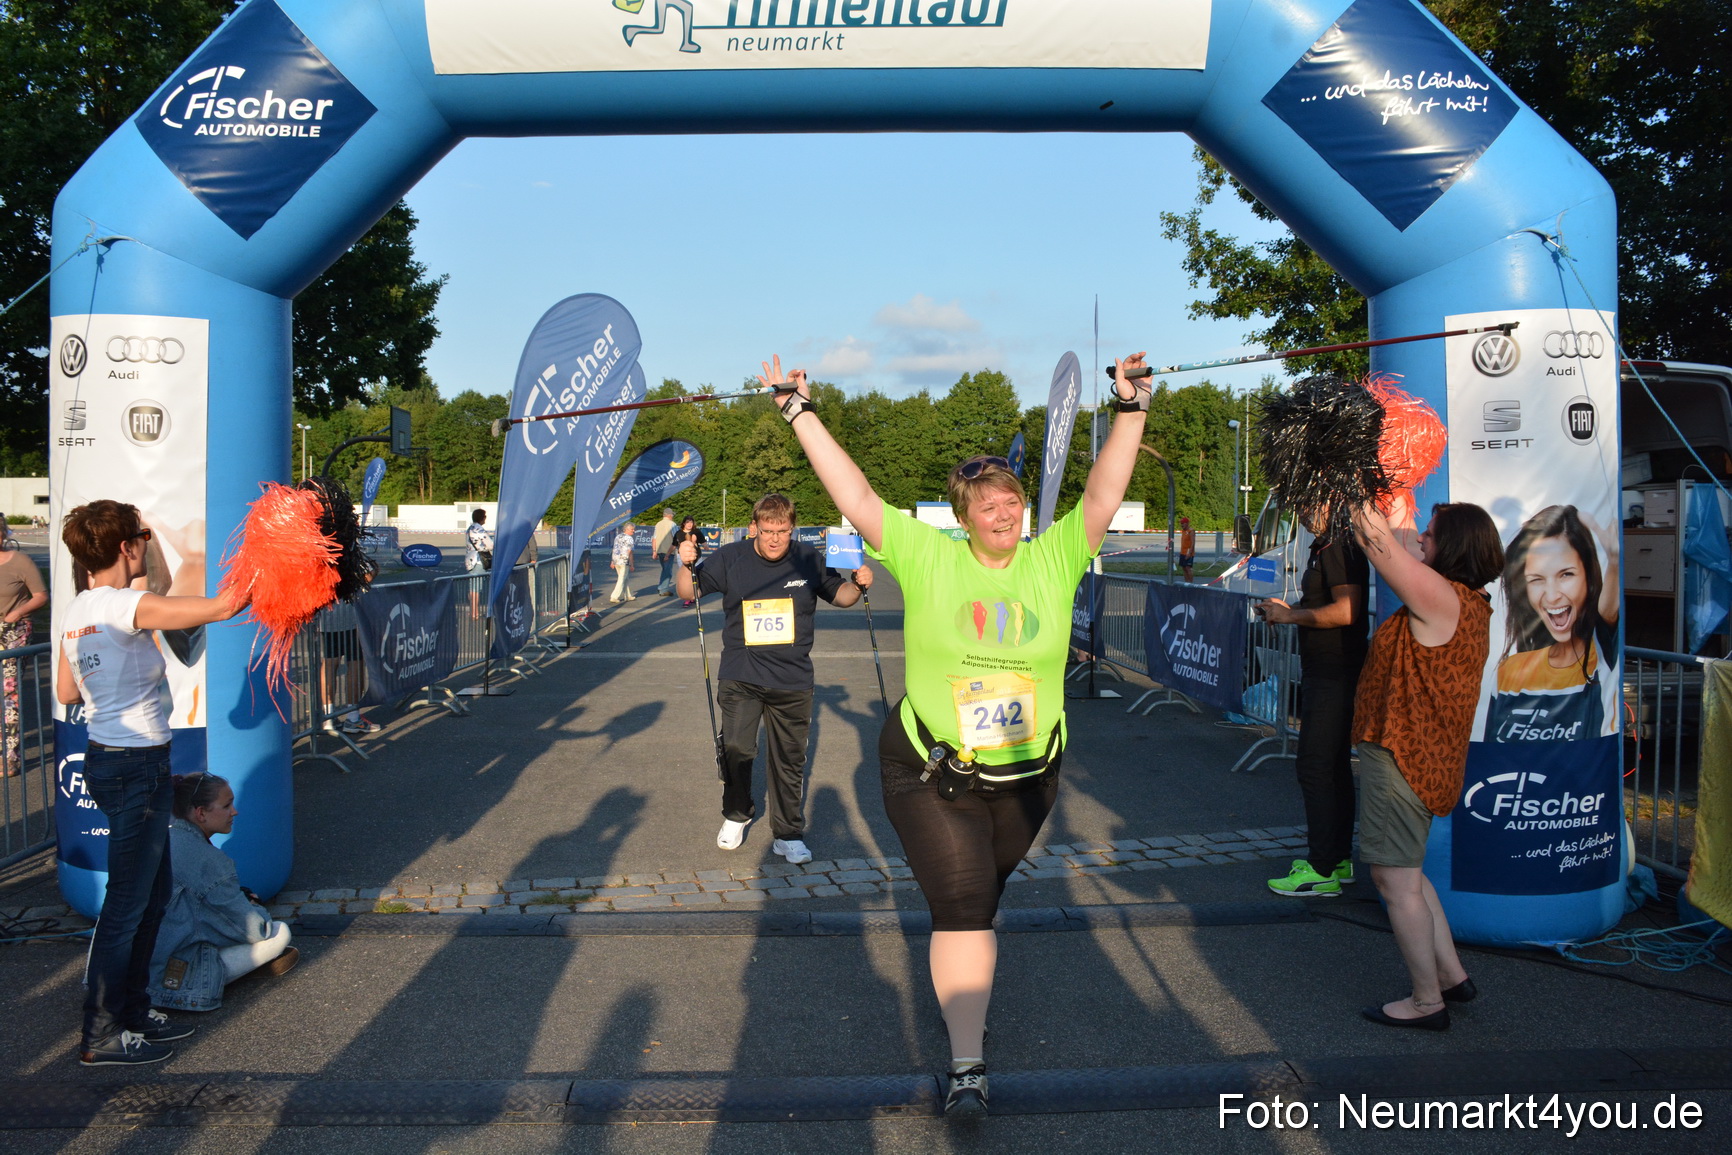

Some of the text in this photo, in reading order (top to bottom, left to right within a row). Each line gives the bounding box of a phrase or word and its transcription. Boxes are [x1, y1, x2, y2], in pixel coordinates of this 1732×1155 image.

[727, 30, 845, 52] neumarkt
[1324, 75, 1367, 100] und
[1374, 69, 1413, 90] das
[1417, 70, 1490, 91] Lächeln
[184, 90, 334, 121] Fischer
[1381, 95, 1488, 126] fährt mit!
[194, 123, 322, 138] AUTOMOBILE
[107, 369, 140, 380] Audi
[542, 323, 614, 436] Fischer
[1546, 366, 1576, 377] Audi
[566, 346, 623, 436] AUTOMOBILE
[132, 412, 161, 435] FIAT
[594, 373, 633, 459] Fischer
[1051, 371, 1075, 460] Fischer
[1571, 410, 1593, 432] FIAT
[58, 437, 96, 447] SEAT
[1470, 438, 1535, 451] SEAT
[608, 469, 677, 510] Frischmann
[652, 465, 700, 493] Druck und Medien
[634, 535, 653, 543] Fisc
[951, 530, 966, 539] AOK
[753, 616, 784, 632] 765
[394, 626, 440, 664] Fischer
[1168, 628, 1222, 668] Fischer
[398, 656, 435, 680] AUTOMOBILE
[961, 660, 1033, 672] Adipositas-Neumarkt
[966, 654, 1029, 666] Selbsthilfegruppe-
[1172, 662, 1219, 687] AUTOMOBILE
[973, 701, 1024, 731] 242
[1506, 720, 1582, 742] Fischer
[1492, 791, 1605, 817] Fischer
[1504, 815, 1599, 831] AUTOMOBILE
[1525, 844, 1552, 859] und
[1555, 839, 1578, 853] das
[1579, 832, 1616, 851] Lächeln
[1558, 844, 1614, 873] fährt mit!
